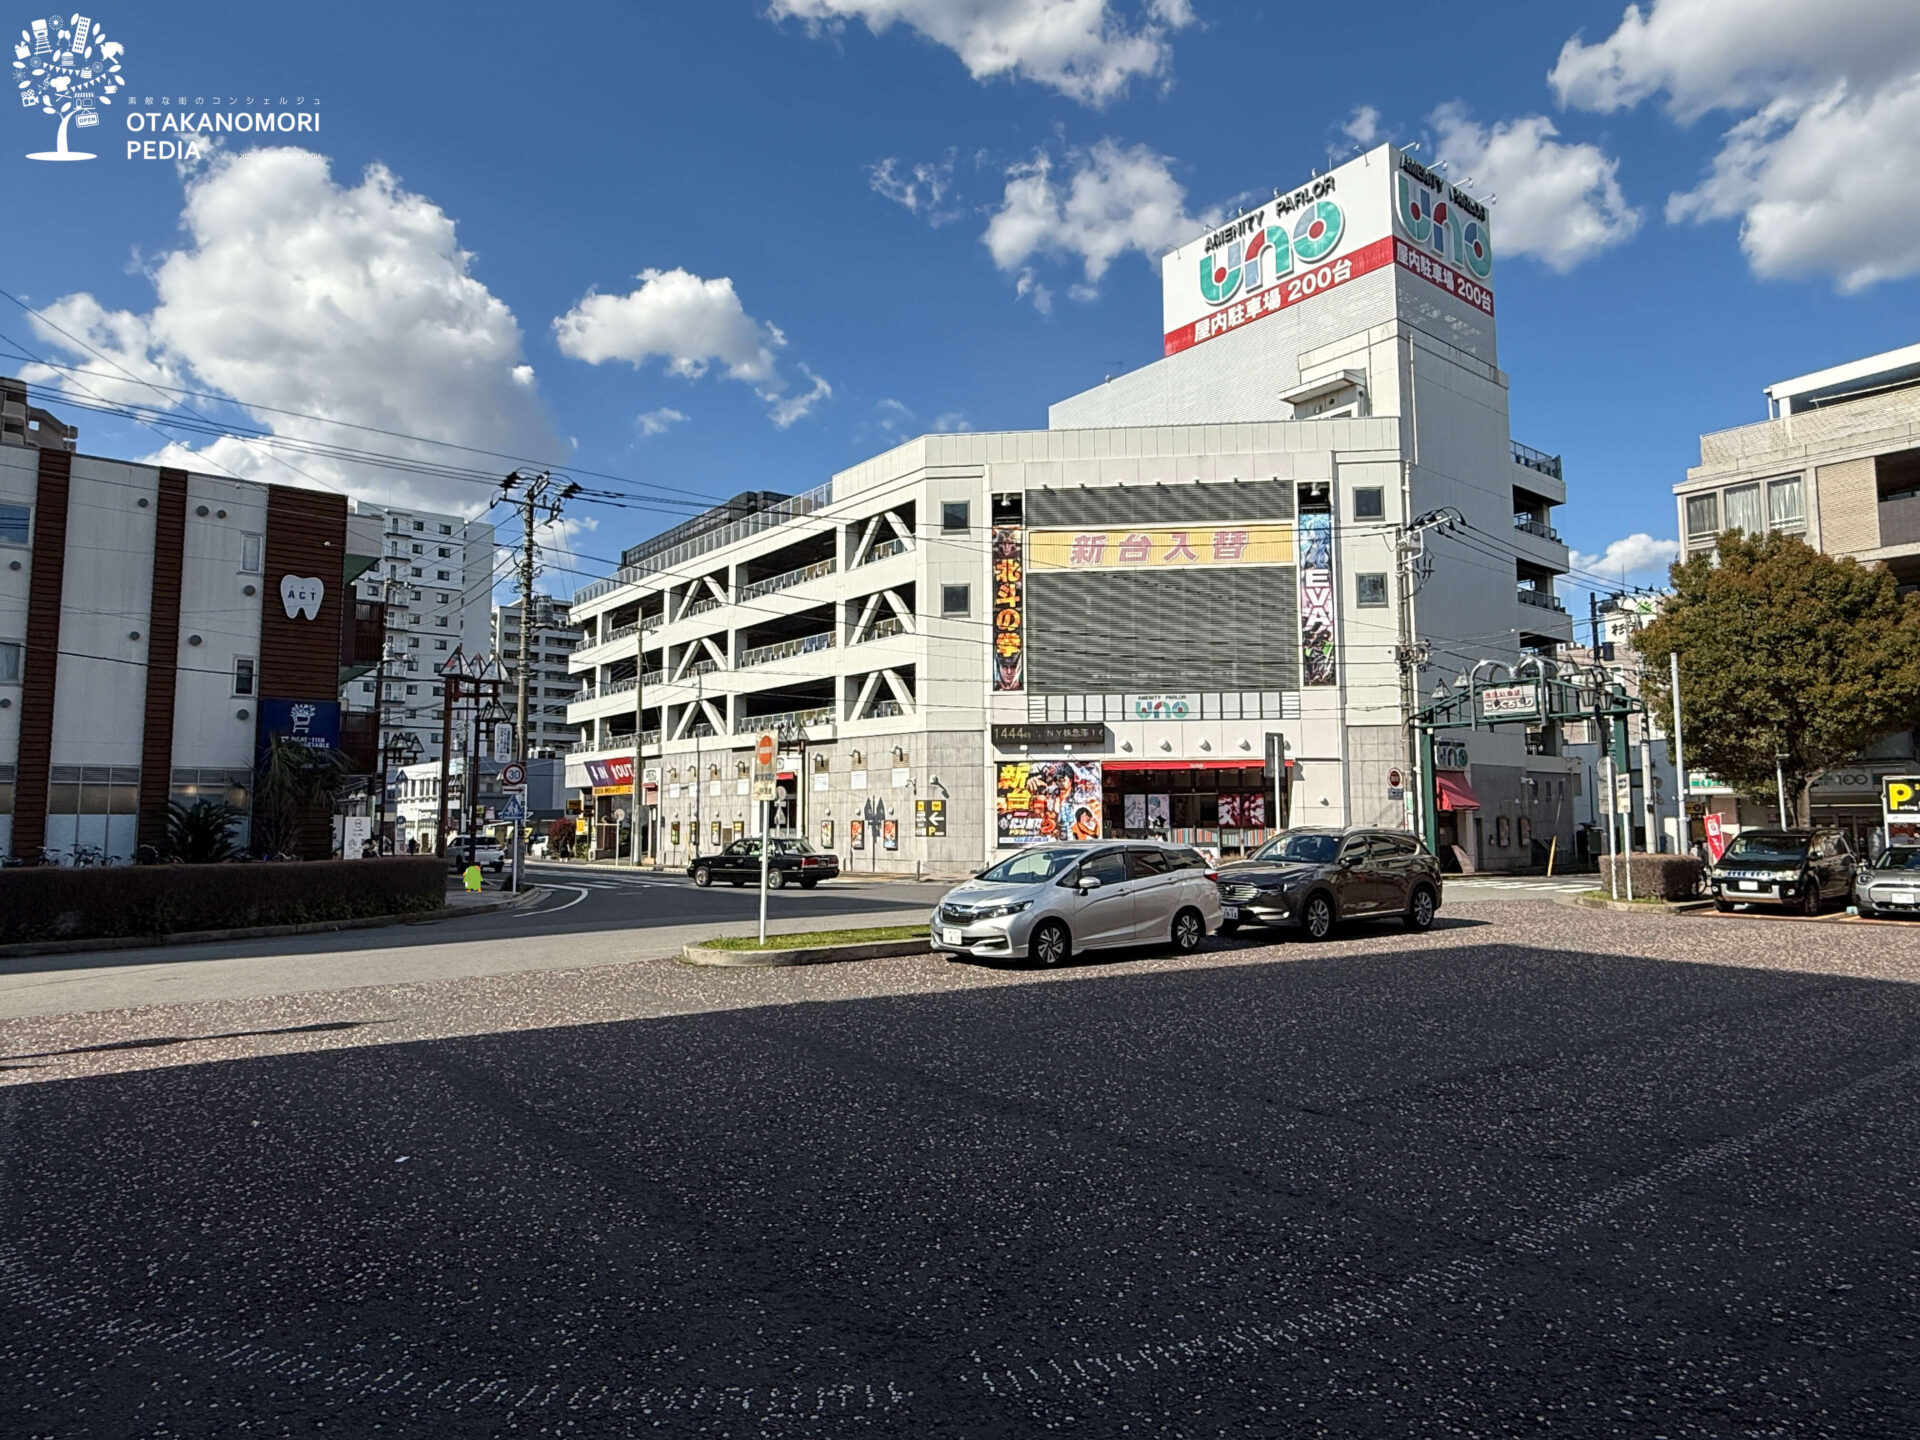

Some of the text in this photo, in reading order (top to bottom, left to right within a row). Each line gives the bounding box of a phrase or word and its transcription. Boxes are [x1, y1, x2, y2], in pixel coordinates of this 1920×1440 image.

[1400, 153, 1445, 195] AMENITY
[1204, 175, 1336, 254] AMENITY PARLOR
[1396, 240, 1492, 313] 屋内駐車場 200台
[1194, 258, 1353, 343] 屋内駐車場 200台
[1069, 530, 1250, 567] 新台入替
[287, 589, 316, 601] ACT
[995, 558, 1022, 658] 北斗の拳
[1305, 568, 1332, 626] EVA
[1135, 701, 1189, 719] uno
[508, 769, 521, 780] 30
[597, 765, 609, 779] IN
[616, 763, 635, 778] OUT
